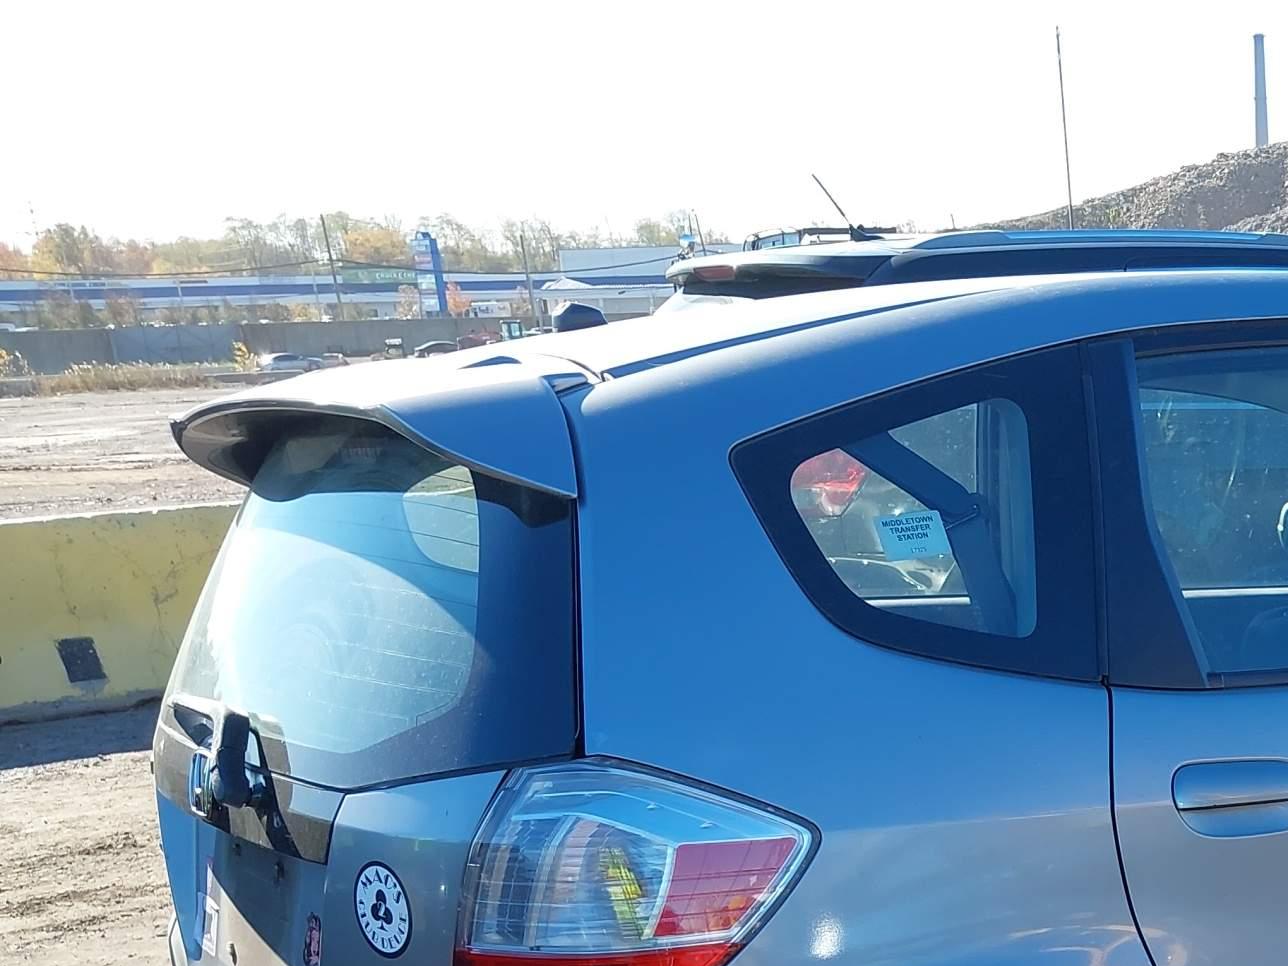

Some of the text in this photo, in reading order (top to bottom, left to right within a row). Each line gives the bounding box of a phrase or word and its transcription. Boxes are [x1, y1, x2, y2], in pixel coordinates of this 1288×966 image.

[881, 515, 934, 528] MIDDLETOWN
[889, 524, 931, 535] TRANSFER
[896, 532, 929, 541] STATION
